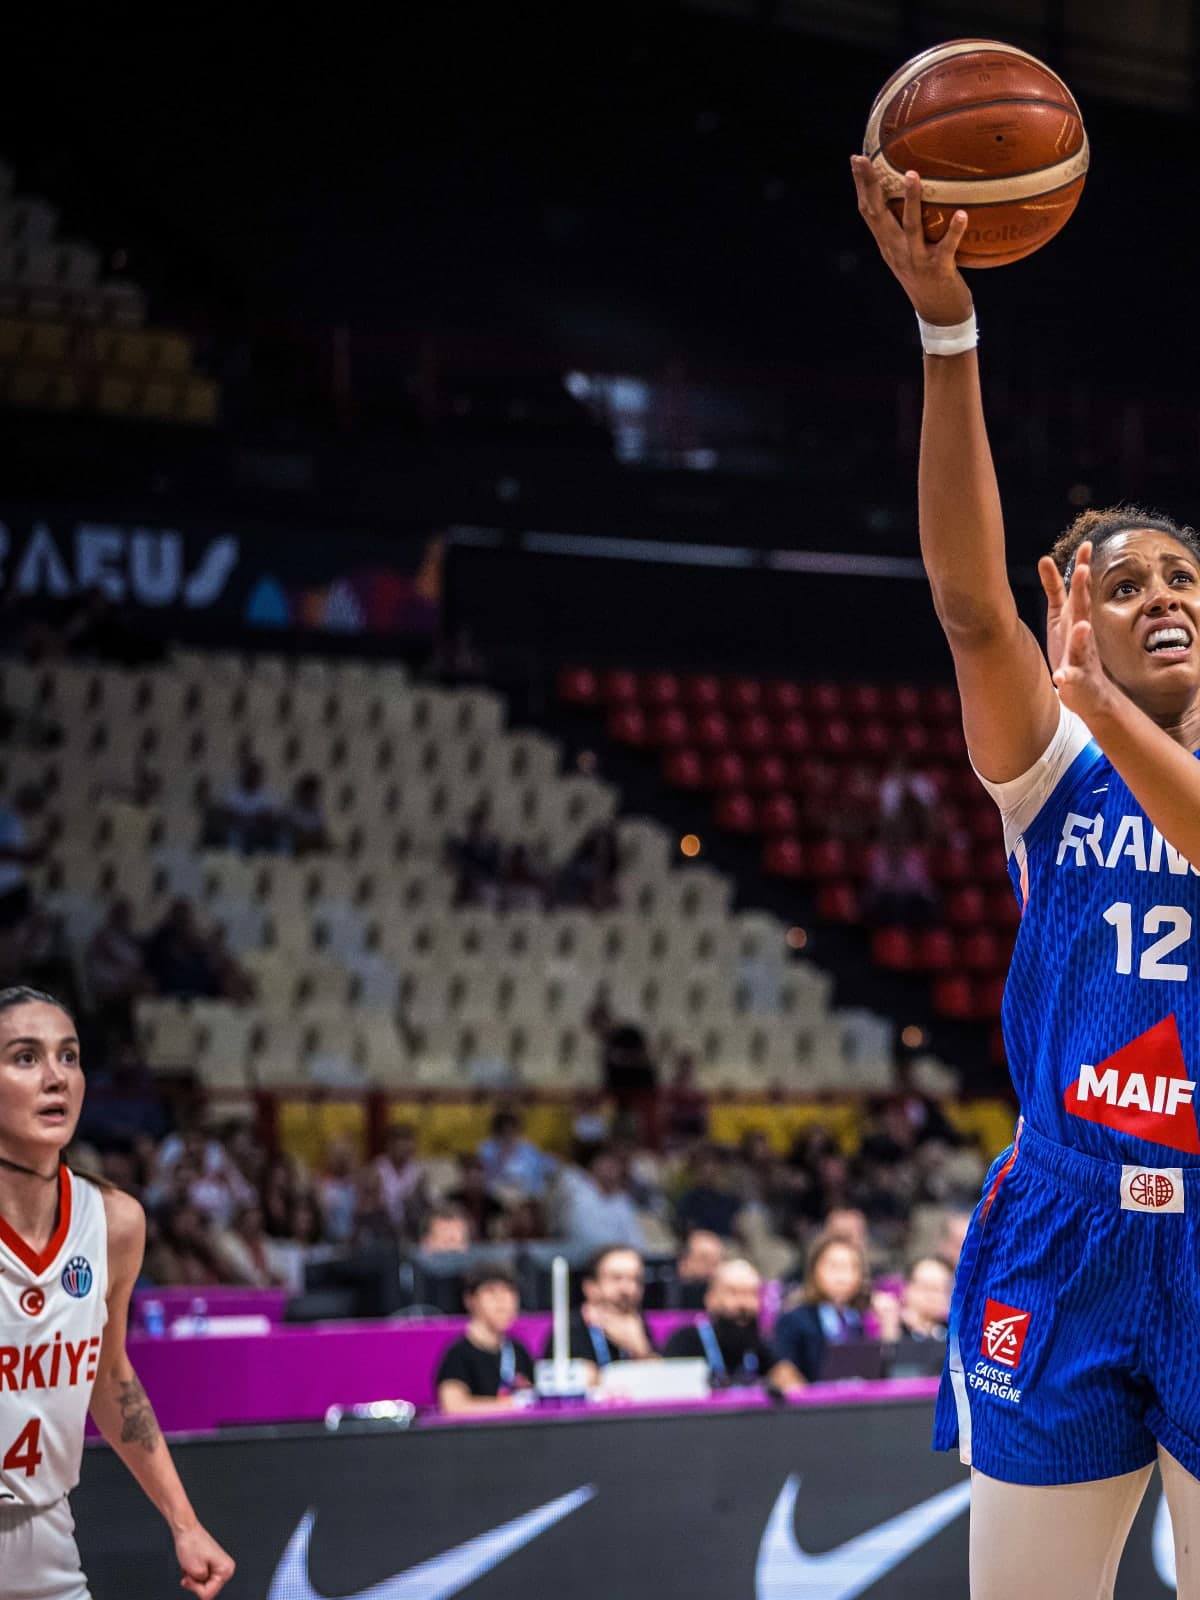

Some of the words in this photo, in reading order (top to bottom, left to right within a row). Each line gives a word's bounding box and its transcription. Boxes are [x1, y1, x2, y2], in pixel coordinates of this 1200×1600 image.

[1102, 902, 1192, 981] 12
[1076, 1064, 1197, 1116] MAIF
[975, 1361, 1012, 1386] CAISSE
[3, 1418, 42, 1477] 4
